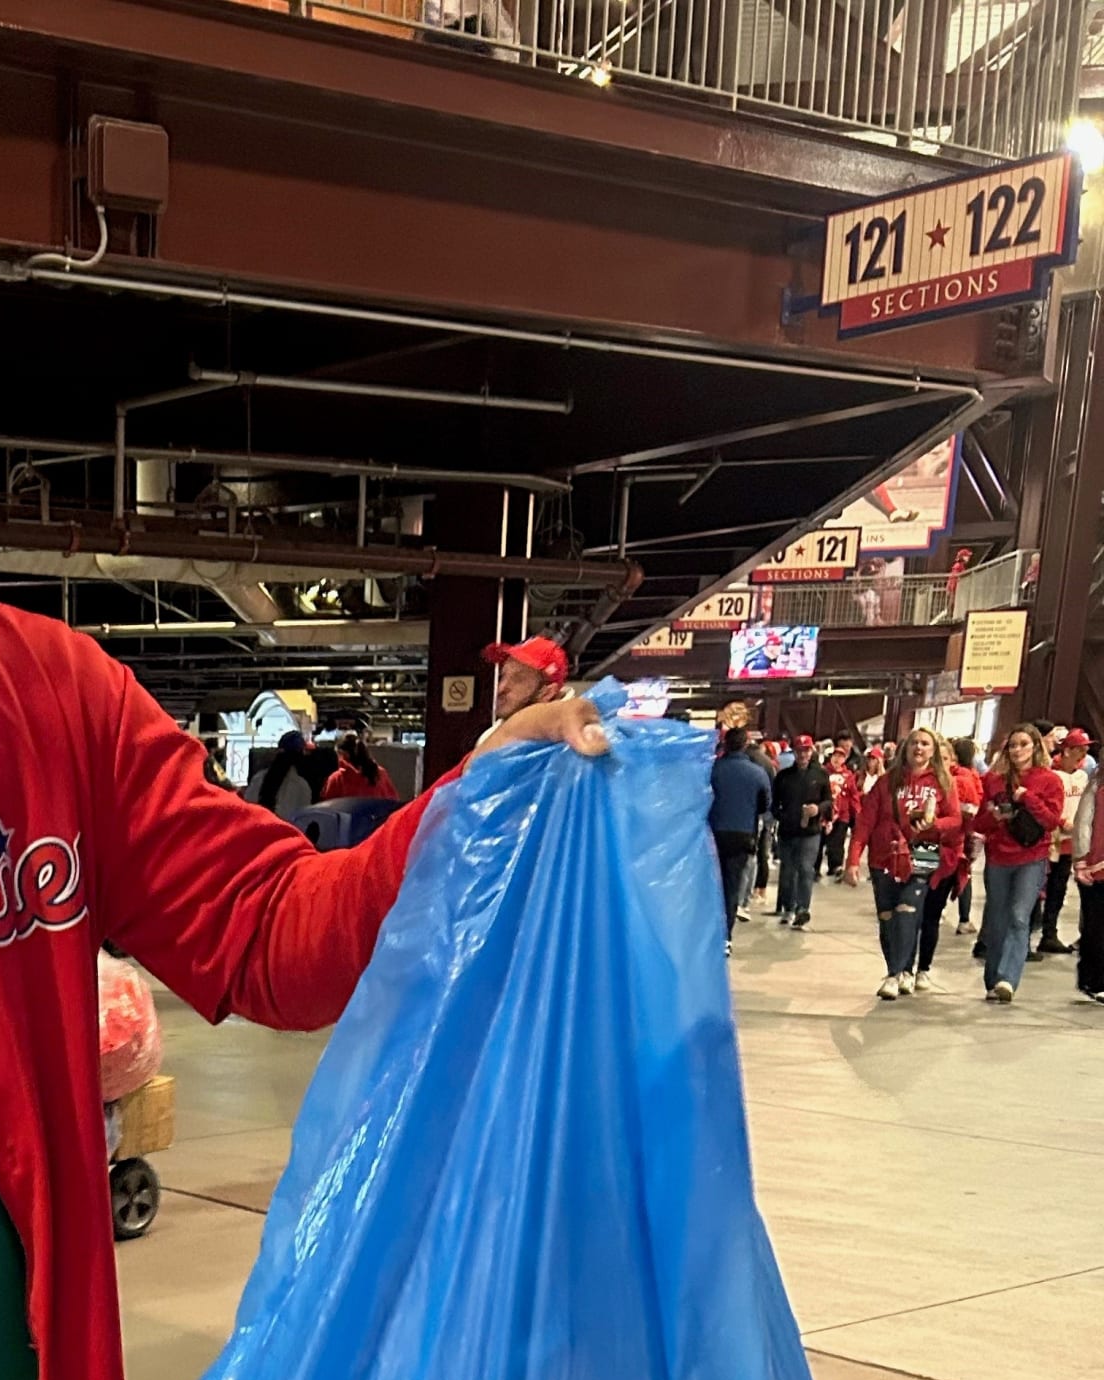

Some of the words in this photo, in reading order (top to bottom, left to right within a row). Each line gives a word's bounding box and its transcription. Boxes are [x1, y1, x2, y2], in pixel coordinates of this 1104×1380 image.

[844, 210, 907, 285] 121
[966, 176, 1046, 257] 122
[871, 270, 998, 318] SECTIONS
[816, 535, 848, 562] 121
[865, 535, 885, 543] INS
[767, 569, 830, 580] SECTIONS
[717, 597, 744, 617] 120
